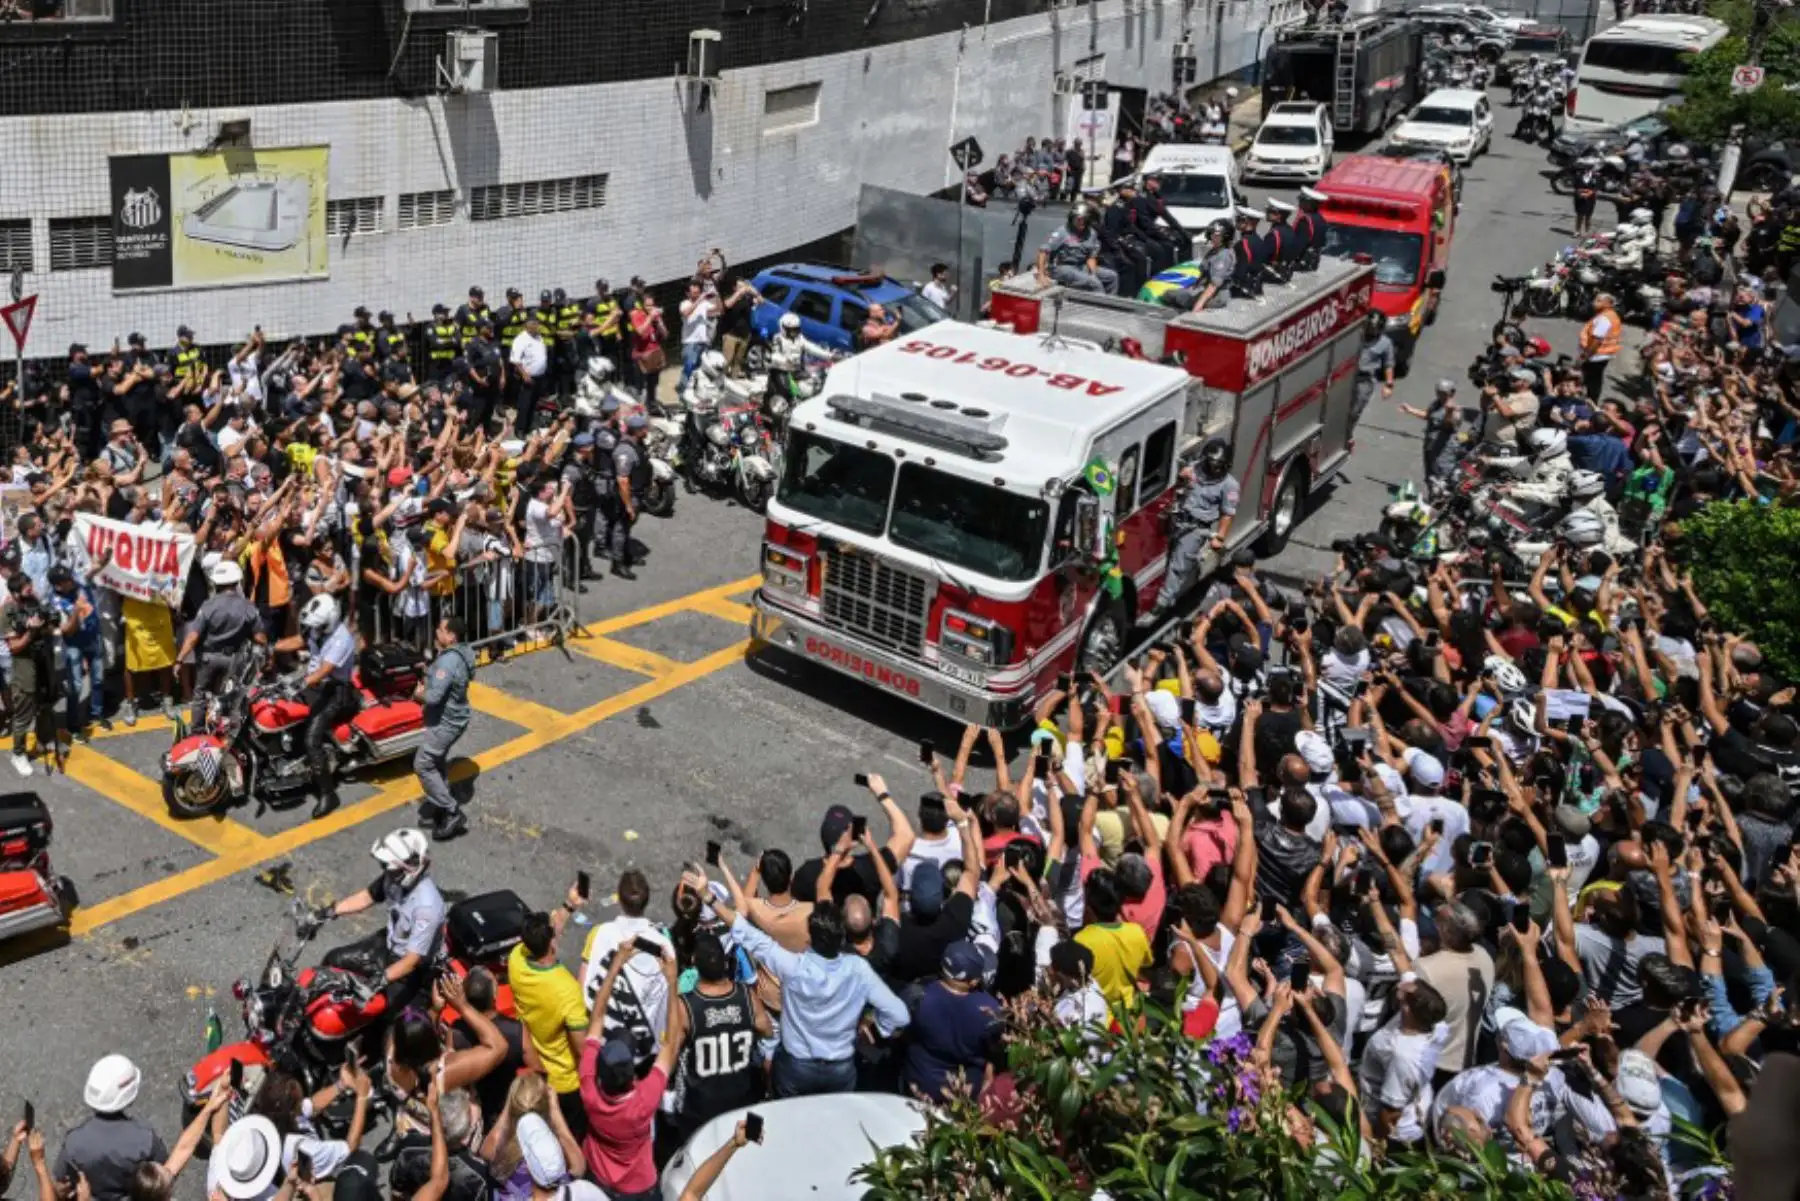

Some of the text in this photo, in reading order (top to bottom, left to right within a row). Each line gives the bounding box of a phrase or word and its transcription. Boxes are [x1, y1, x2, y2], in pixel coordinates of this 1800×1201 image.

[1248, 299, 1339, 378] BOMBEIROS
[899, 340, 1125, 396] AB-06105
[695, 1030, 753, 1078] 013
